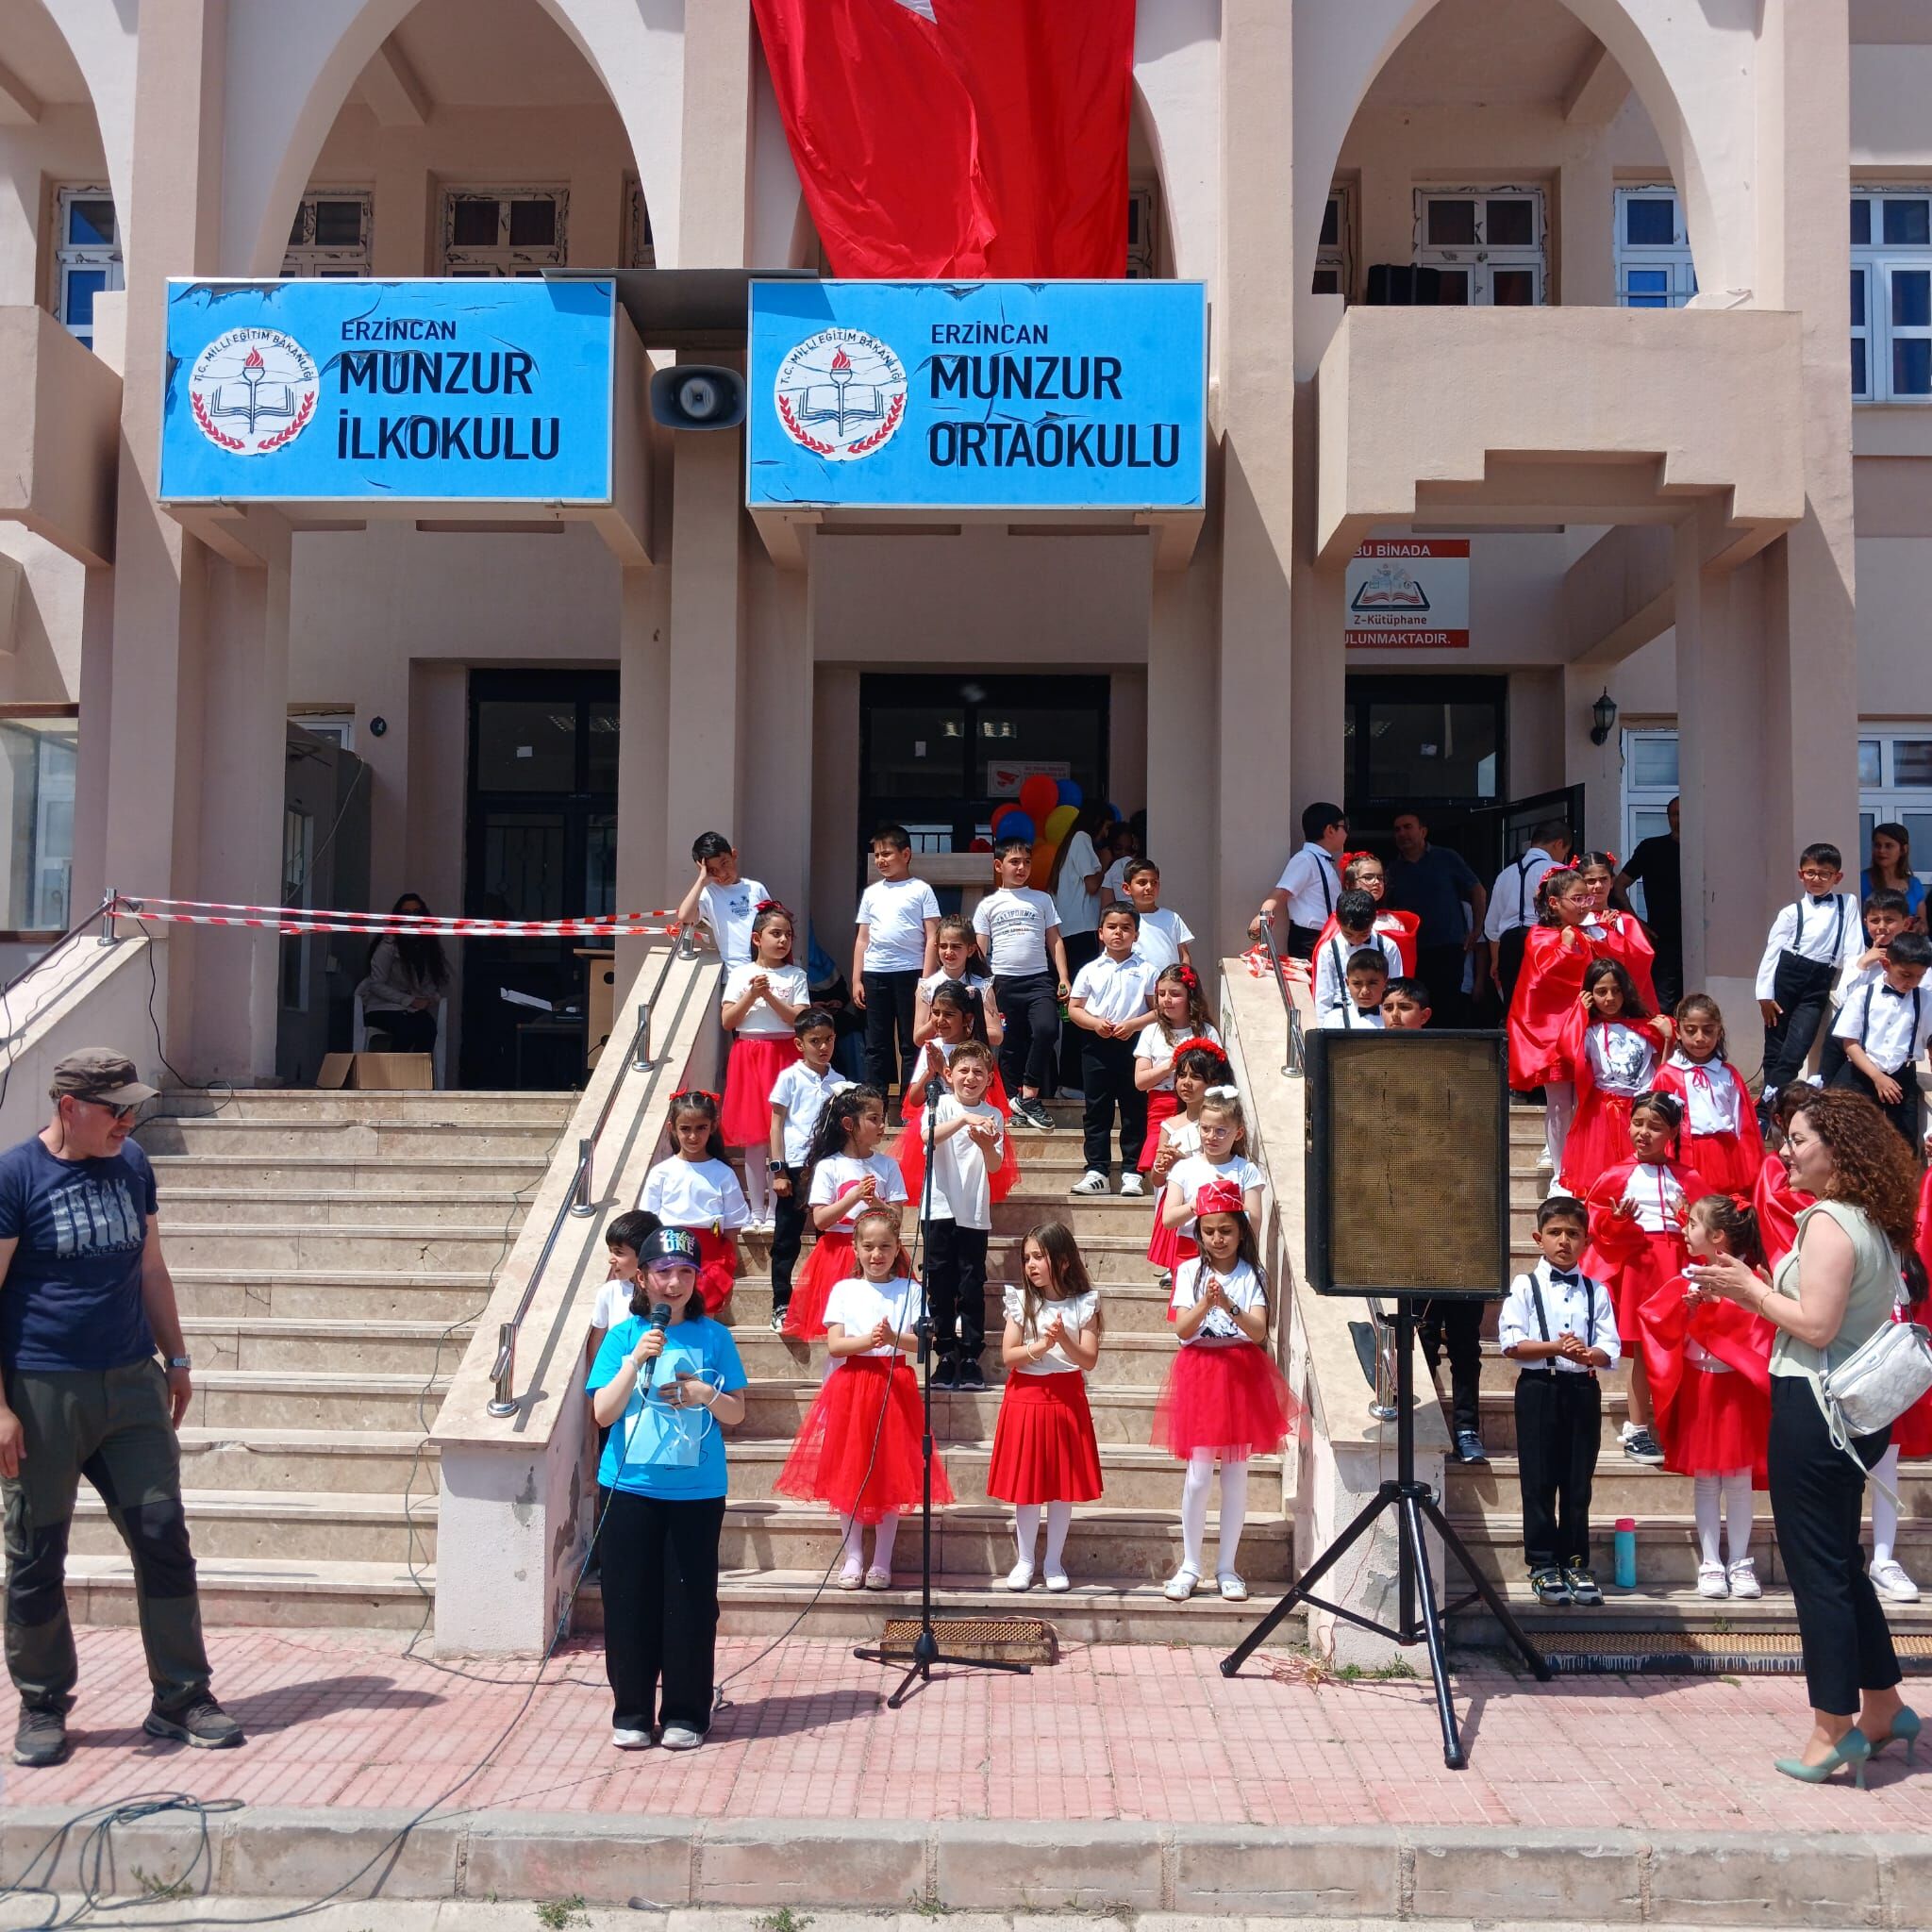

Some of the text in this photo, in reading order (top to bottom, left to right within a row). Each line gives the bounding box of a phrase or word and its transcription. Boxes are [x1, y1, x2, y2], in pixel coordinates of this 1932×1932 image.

[341, 317, 458, 341] ERZİNCAN
[931, 321, 1049, 344] ERZİNCAN
[339, 352, 534, 395] MUNZUR
[929, 356, 1124, 400] MUNZUR
[338, 408, 560, 460] İLKOKULU
[929, 422, 1180, 468] ORTAOKULU
[1376, 542, 1431, 557] BİNADA
[1354, 614, 1427, 626] Z-Kütüphane
[1345, 633, 1451, 644] LUNMAKTADIR.
